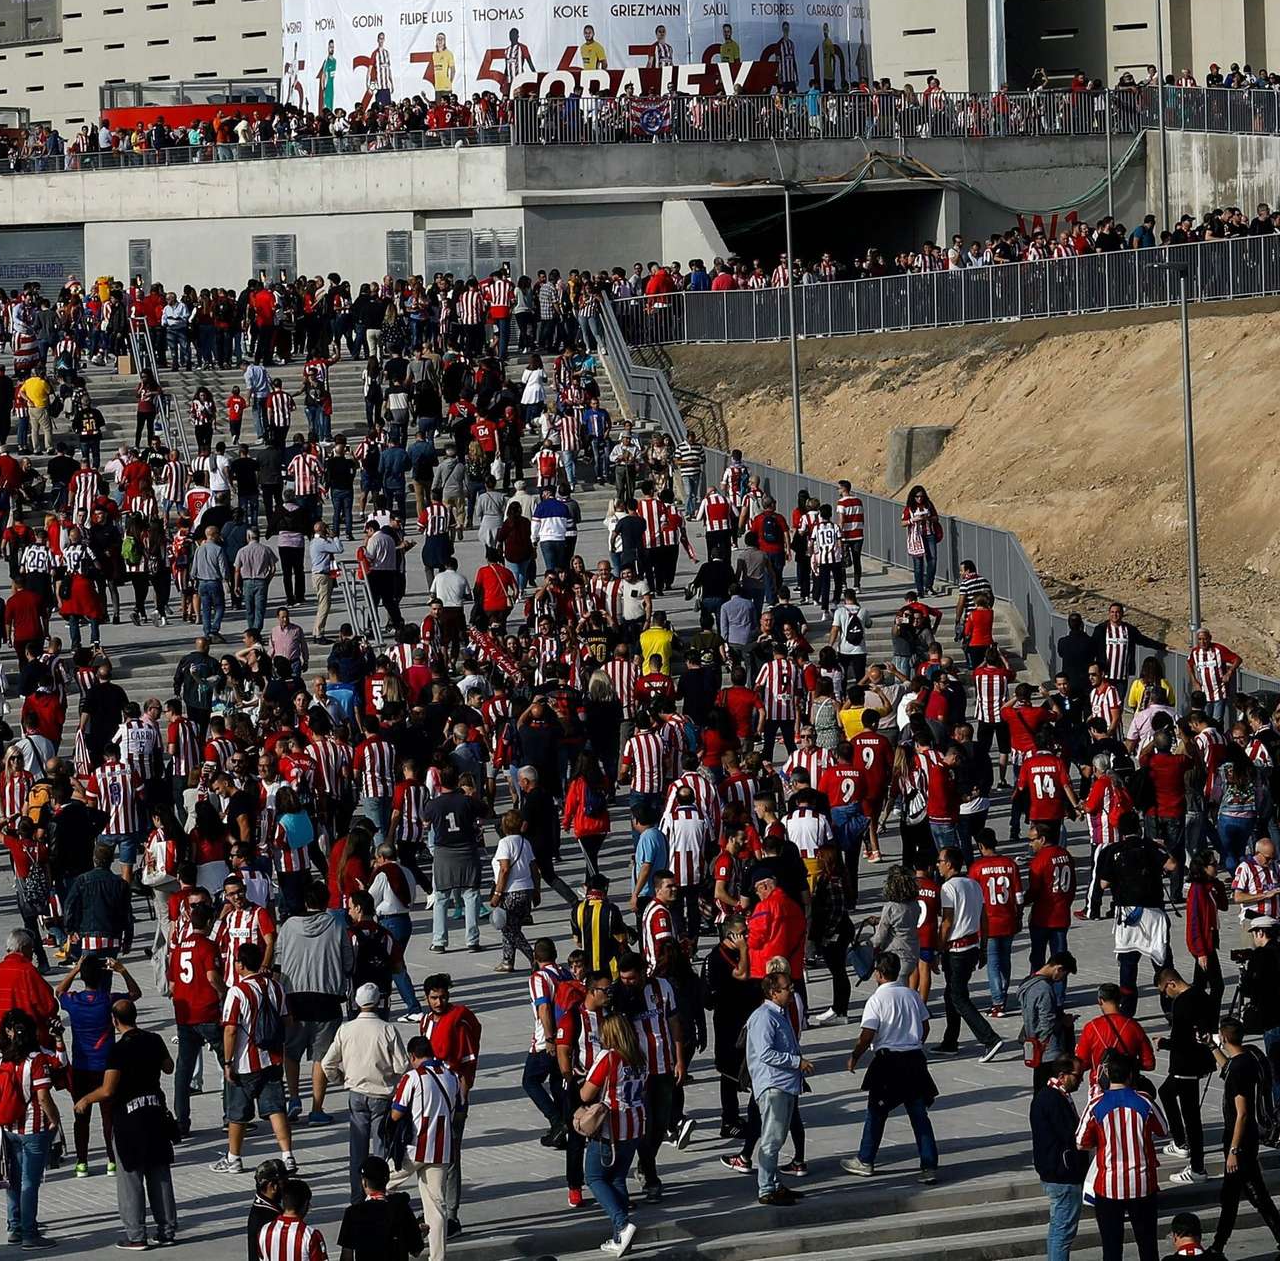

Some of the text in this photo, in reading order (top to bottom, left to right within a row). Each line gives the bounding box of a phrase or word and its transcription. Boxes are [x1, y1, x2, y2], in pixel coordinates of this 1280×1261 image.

[400, 10, 453, 26] FILIPE LUIS
[472, 7, 524, 22] THOMAS
[553, 5, 589, 18] KOKE
[610, 3, 681, 17] GRIEZMANN
[806, 4, 843, 17] CARRASCO
[315, 18, 336, 32] MOYA
[352, 13, 383, 29] GODÍN
[820, 530, 833, 545] 19
[862, 746, 875, 770] 9
[841, 777, 855, 803] 9
[1033, 774, 1056, 799] 14
[445, 812, 460, 833] 1
[981, 866, 1006, 875] MIGUEL
[987, 875, 1010, 906] 13
[179, 950, 194, 984] 5
[126, 1096, 145, 1114] NEW
